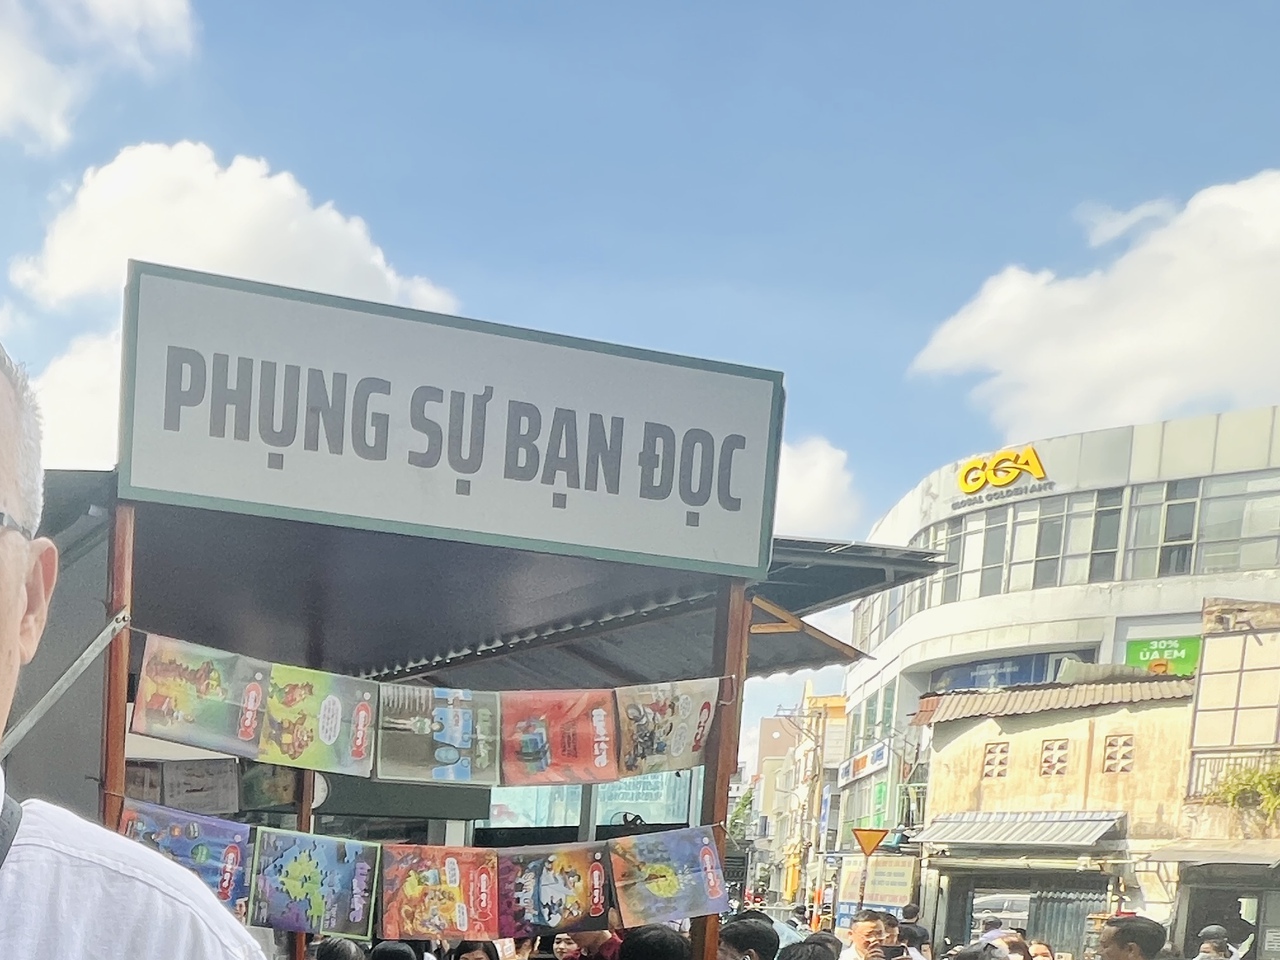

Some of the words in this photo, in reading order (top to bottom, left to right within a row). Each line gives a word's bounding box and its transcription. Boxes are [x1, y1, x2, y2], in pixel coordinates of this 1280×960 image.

[164, 345, 392, 470] PHỤNG
[407, 385, 494, 496] SỰ
[504, 400, 624, 509] BẠN
[638, 420, 749, 527] ĐỌC
[958, 446, 1045, 495] GGA
[1150, 640, 1179, 650] 30%
[1164, 649, 1186, 659] EM
